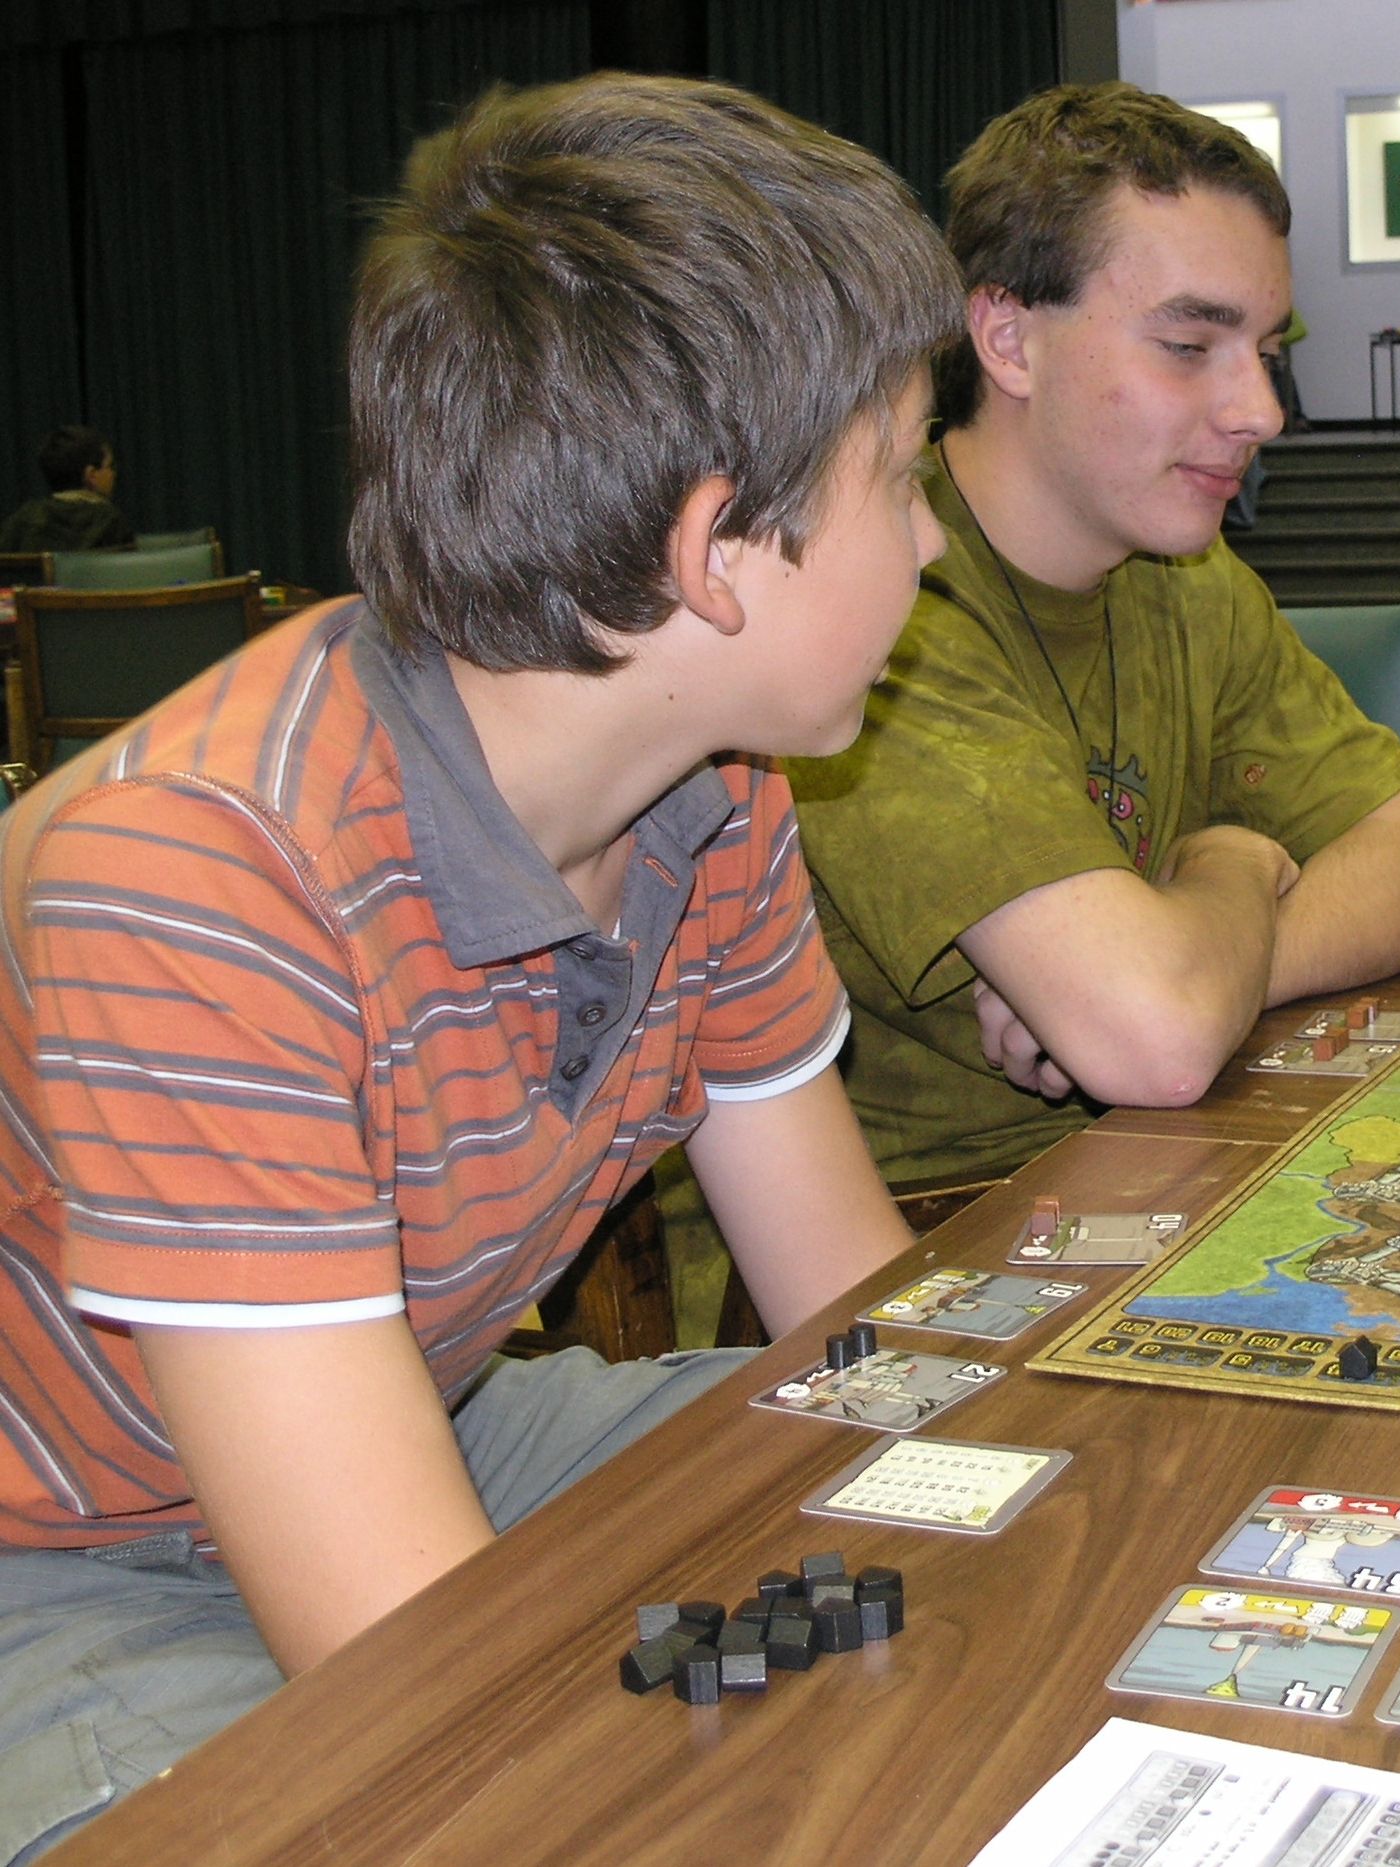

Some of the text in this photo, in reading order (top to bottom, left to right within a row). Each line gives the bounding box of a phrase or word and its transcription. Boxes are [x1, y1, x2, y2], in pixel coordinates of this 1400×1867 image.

[1148, 1213, 1183, 1231] 04
[1039, 1280, 1086, 1299] 19
[947, 1362, 1000, 1385] 21
[1281, 1679, 1345, 1714] 14
